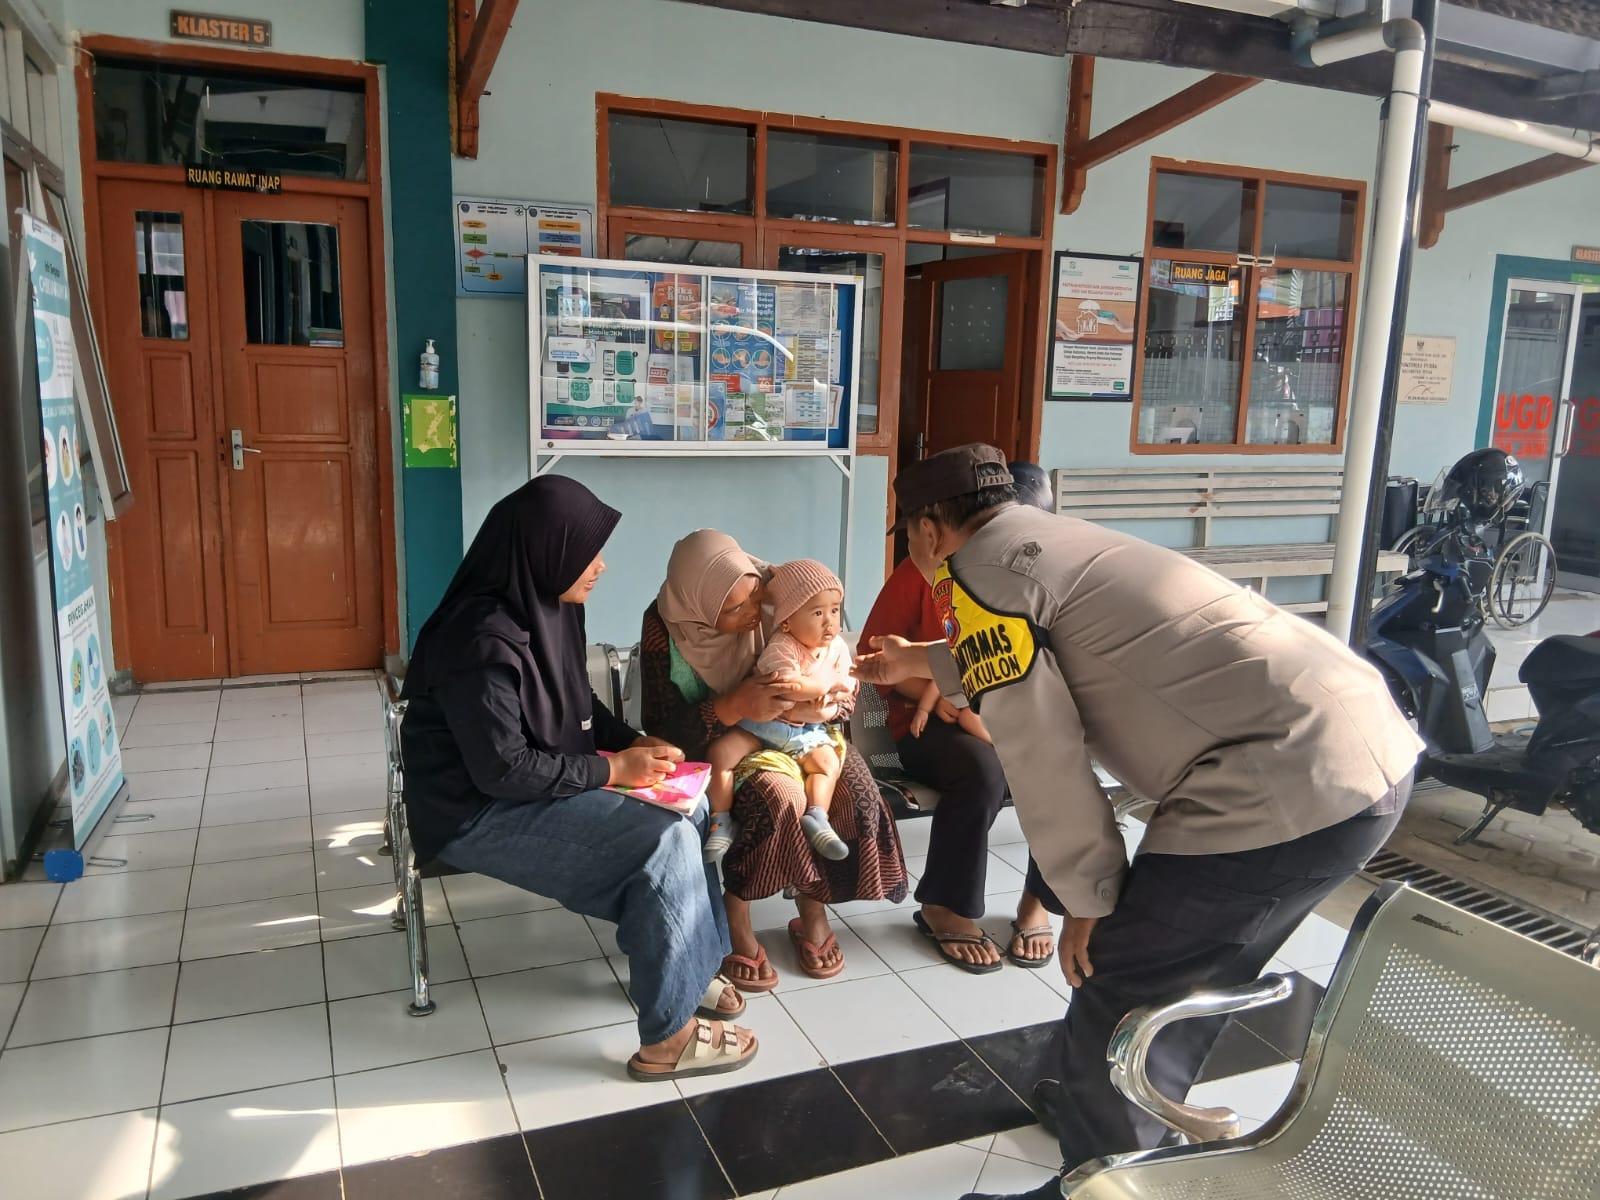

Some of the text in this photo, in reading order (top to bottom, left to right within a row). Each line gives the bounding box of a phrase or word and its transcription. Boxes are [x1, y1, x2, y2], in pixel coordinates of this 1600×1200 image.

[177, 15, 265, 43] KLASTER 5
[188, 168, 280, 190] RUANG RAWAT INAP
[1175, 266, 1226, 282] RUANG JAGA
[1497, 393, 1553, 431] UGD
[973, 654, 1021, 689] KULON
